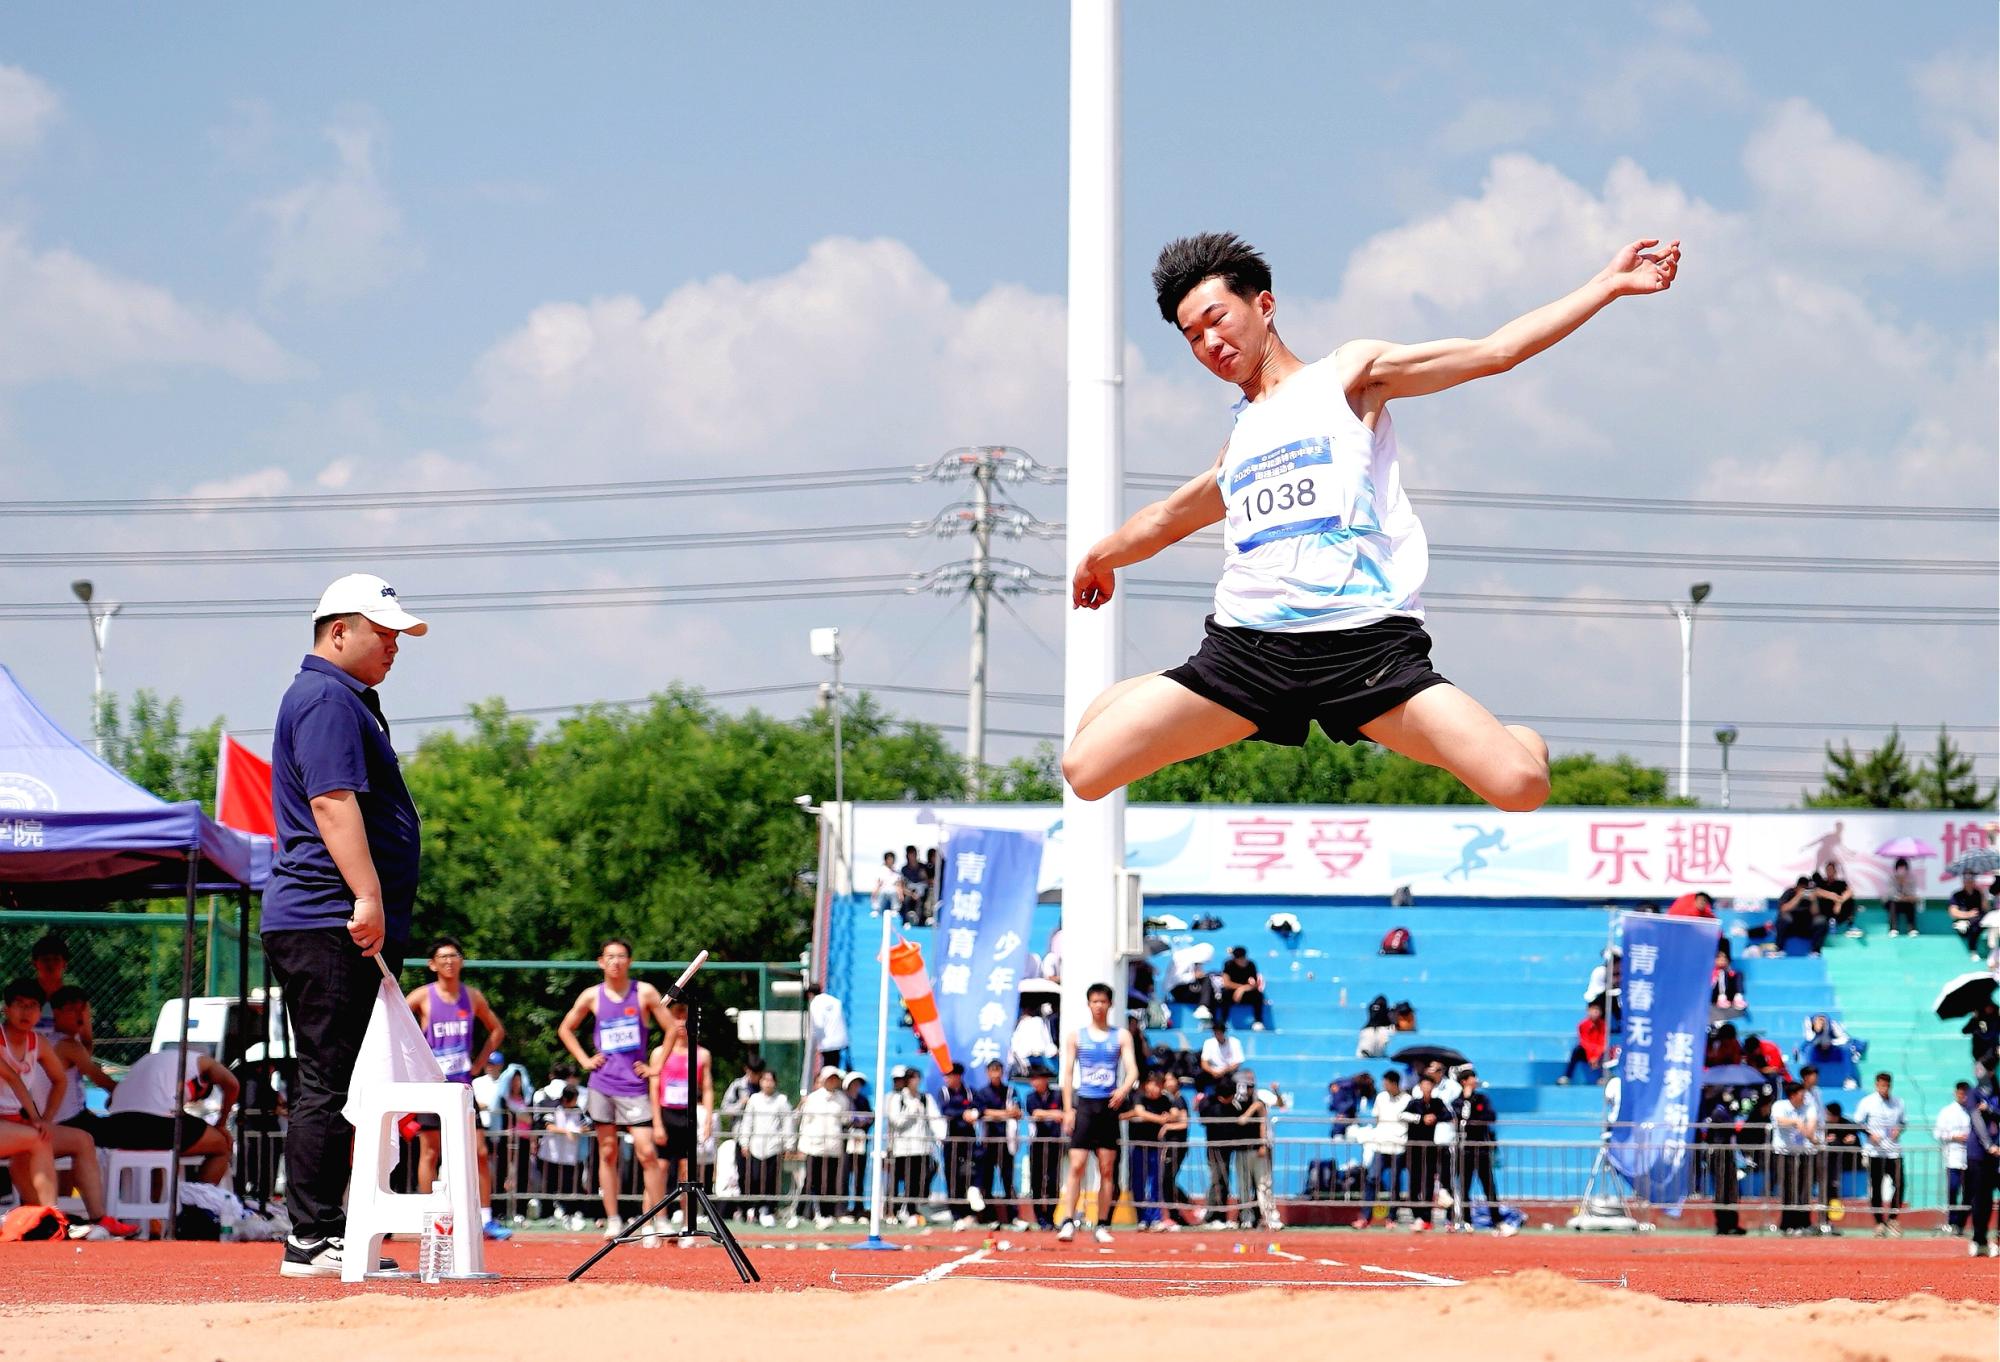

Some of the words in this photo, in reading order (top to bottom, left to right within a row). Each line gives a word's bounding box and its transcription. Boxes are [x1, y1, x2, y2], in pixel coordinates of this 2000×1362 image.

[1242, 478, 1316, 522] 1038
[1226, 816, 1371, 881] 享受
[1587, 818, 1732, 884] 乐趣
[942, 852, 987, 994] 青城育健
[970, 929, 1022, 1068] 少年争先
[1624, 943, 1659, 1083] 青春无畏
